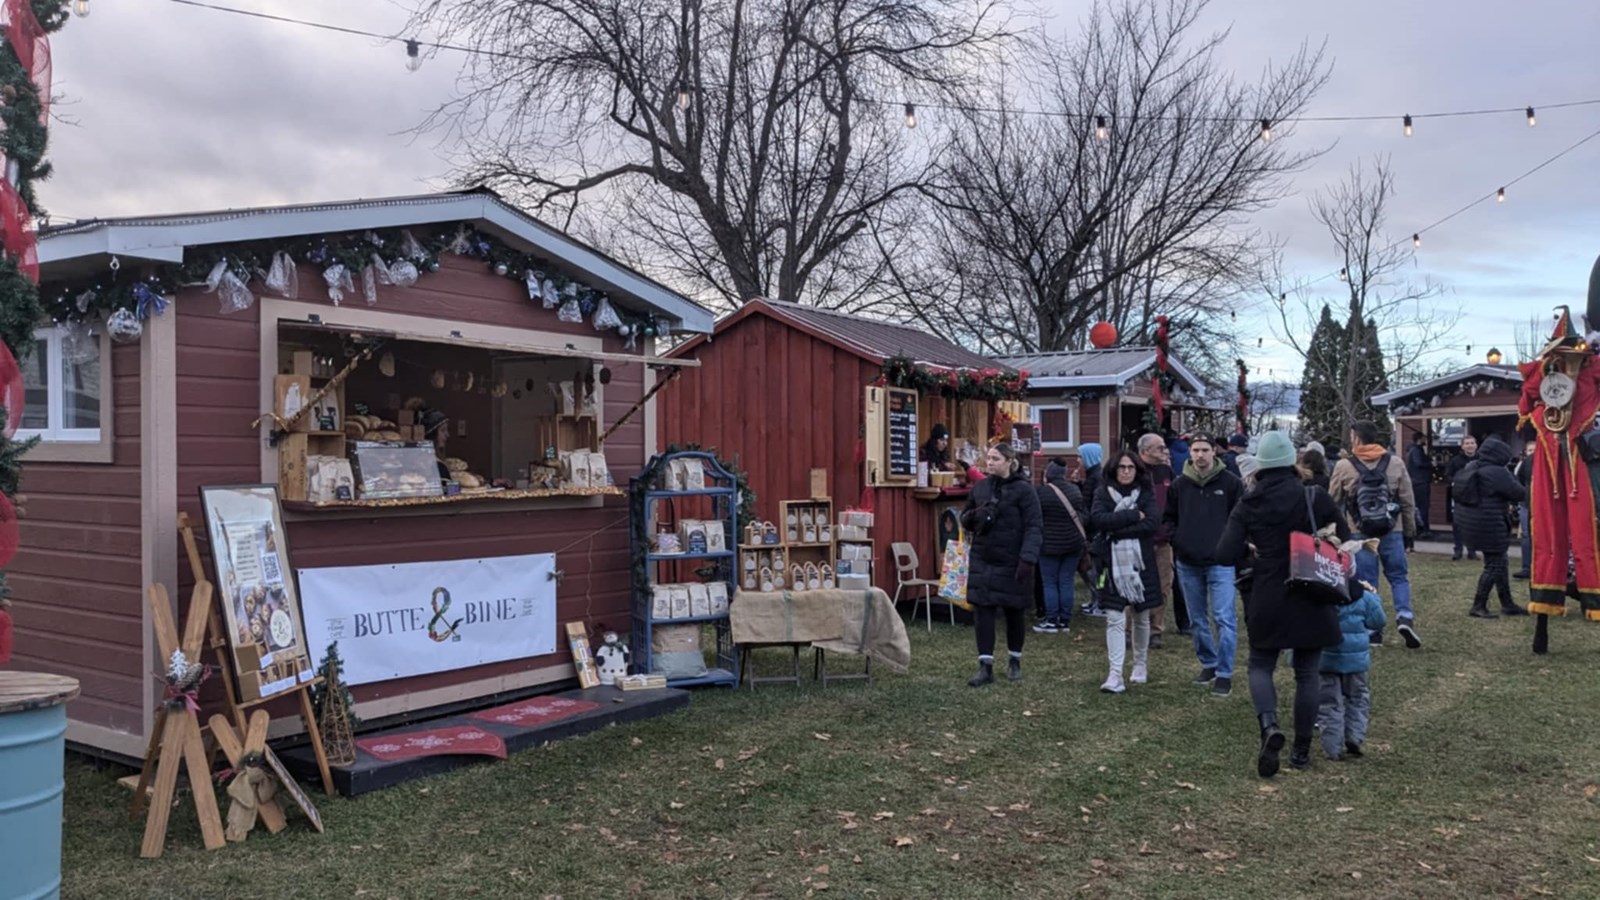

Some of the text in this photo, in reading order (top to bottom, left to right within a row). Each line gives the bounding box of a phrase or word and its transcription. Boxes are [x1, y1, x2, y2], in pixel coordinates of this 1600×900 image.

[354, 586, 516, 643] BUTTE & BINE
